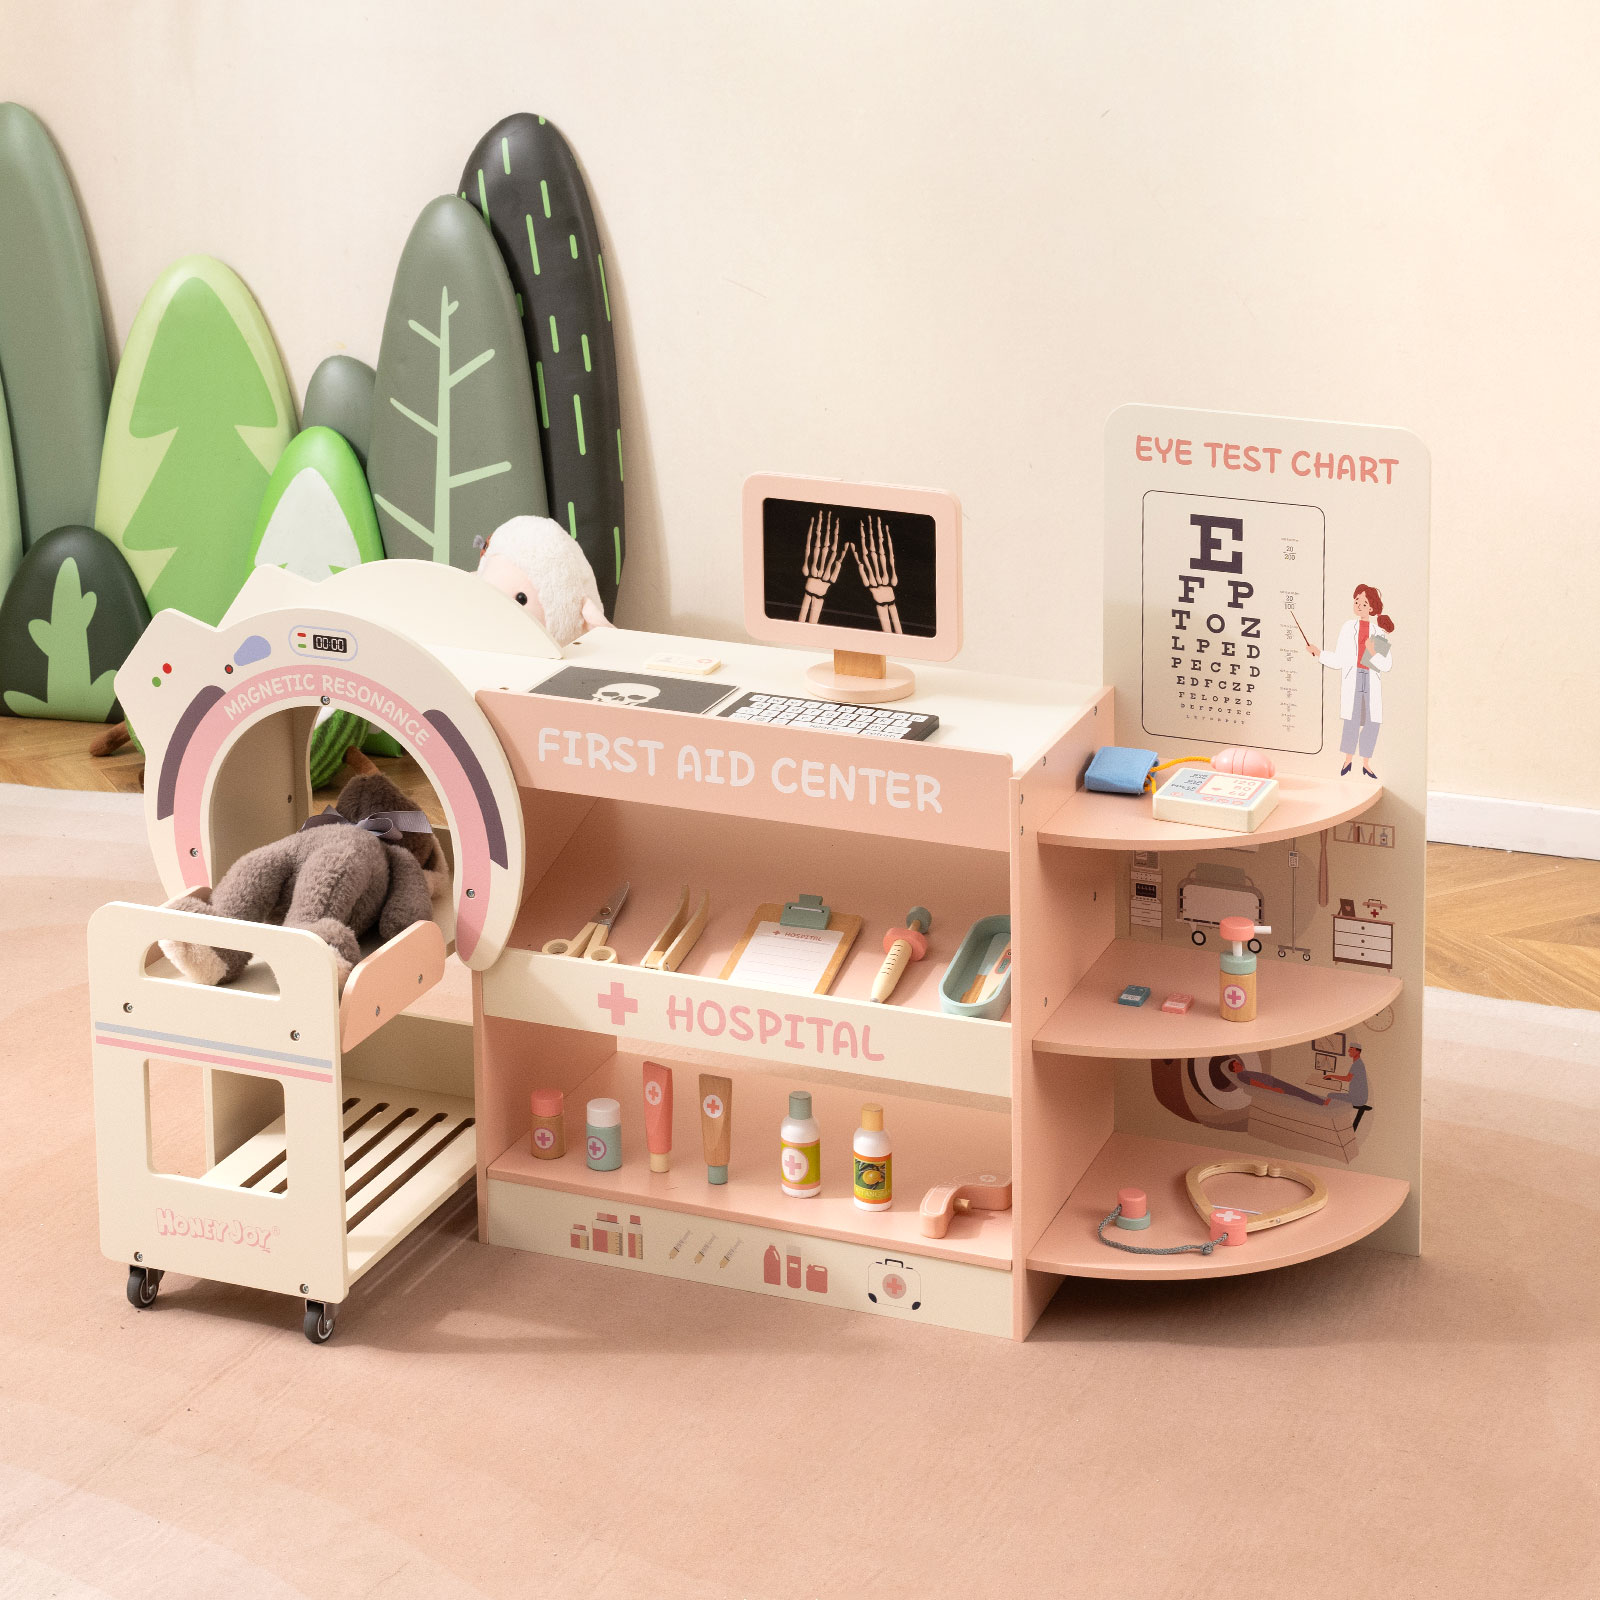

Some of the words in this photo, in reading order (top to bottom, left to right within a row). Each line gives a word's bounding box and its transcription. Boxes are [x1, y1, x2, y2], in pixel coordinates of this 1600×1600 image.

[1136, 435, 1193, 465] EYE
[1204, 442, 1282, 474] TEST
[1291, 451, 1400, 485] CHART
[1190, 513, 1244, 574] E
[315, 636, 346, 651] 00:00
[224, 674, 316, 720] MAGNETIC
[322, 674, 431, 747] RESONANCE
[538, 728, 664, 777] FIRST
[677, 745, 755, 787] AID
[771, 757, 943, 814] CENTER
[784, 931, 823, 942] HOSPITAL
[666, 994, 886, 1062] HOSPITAL
